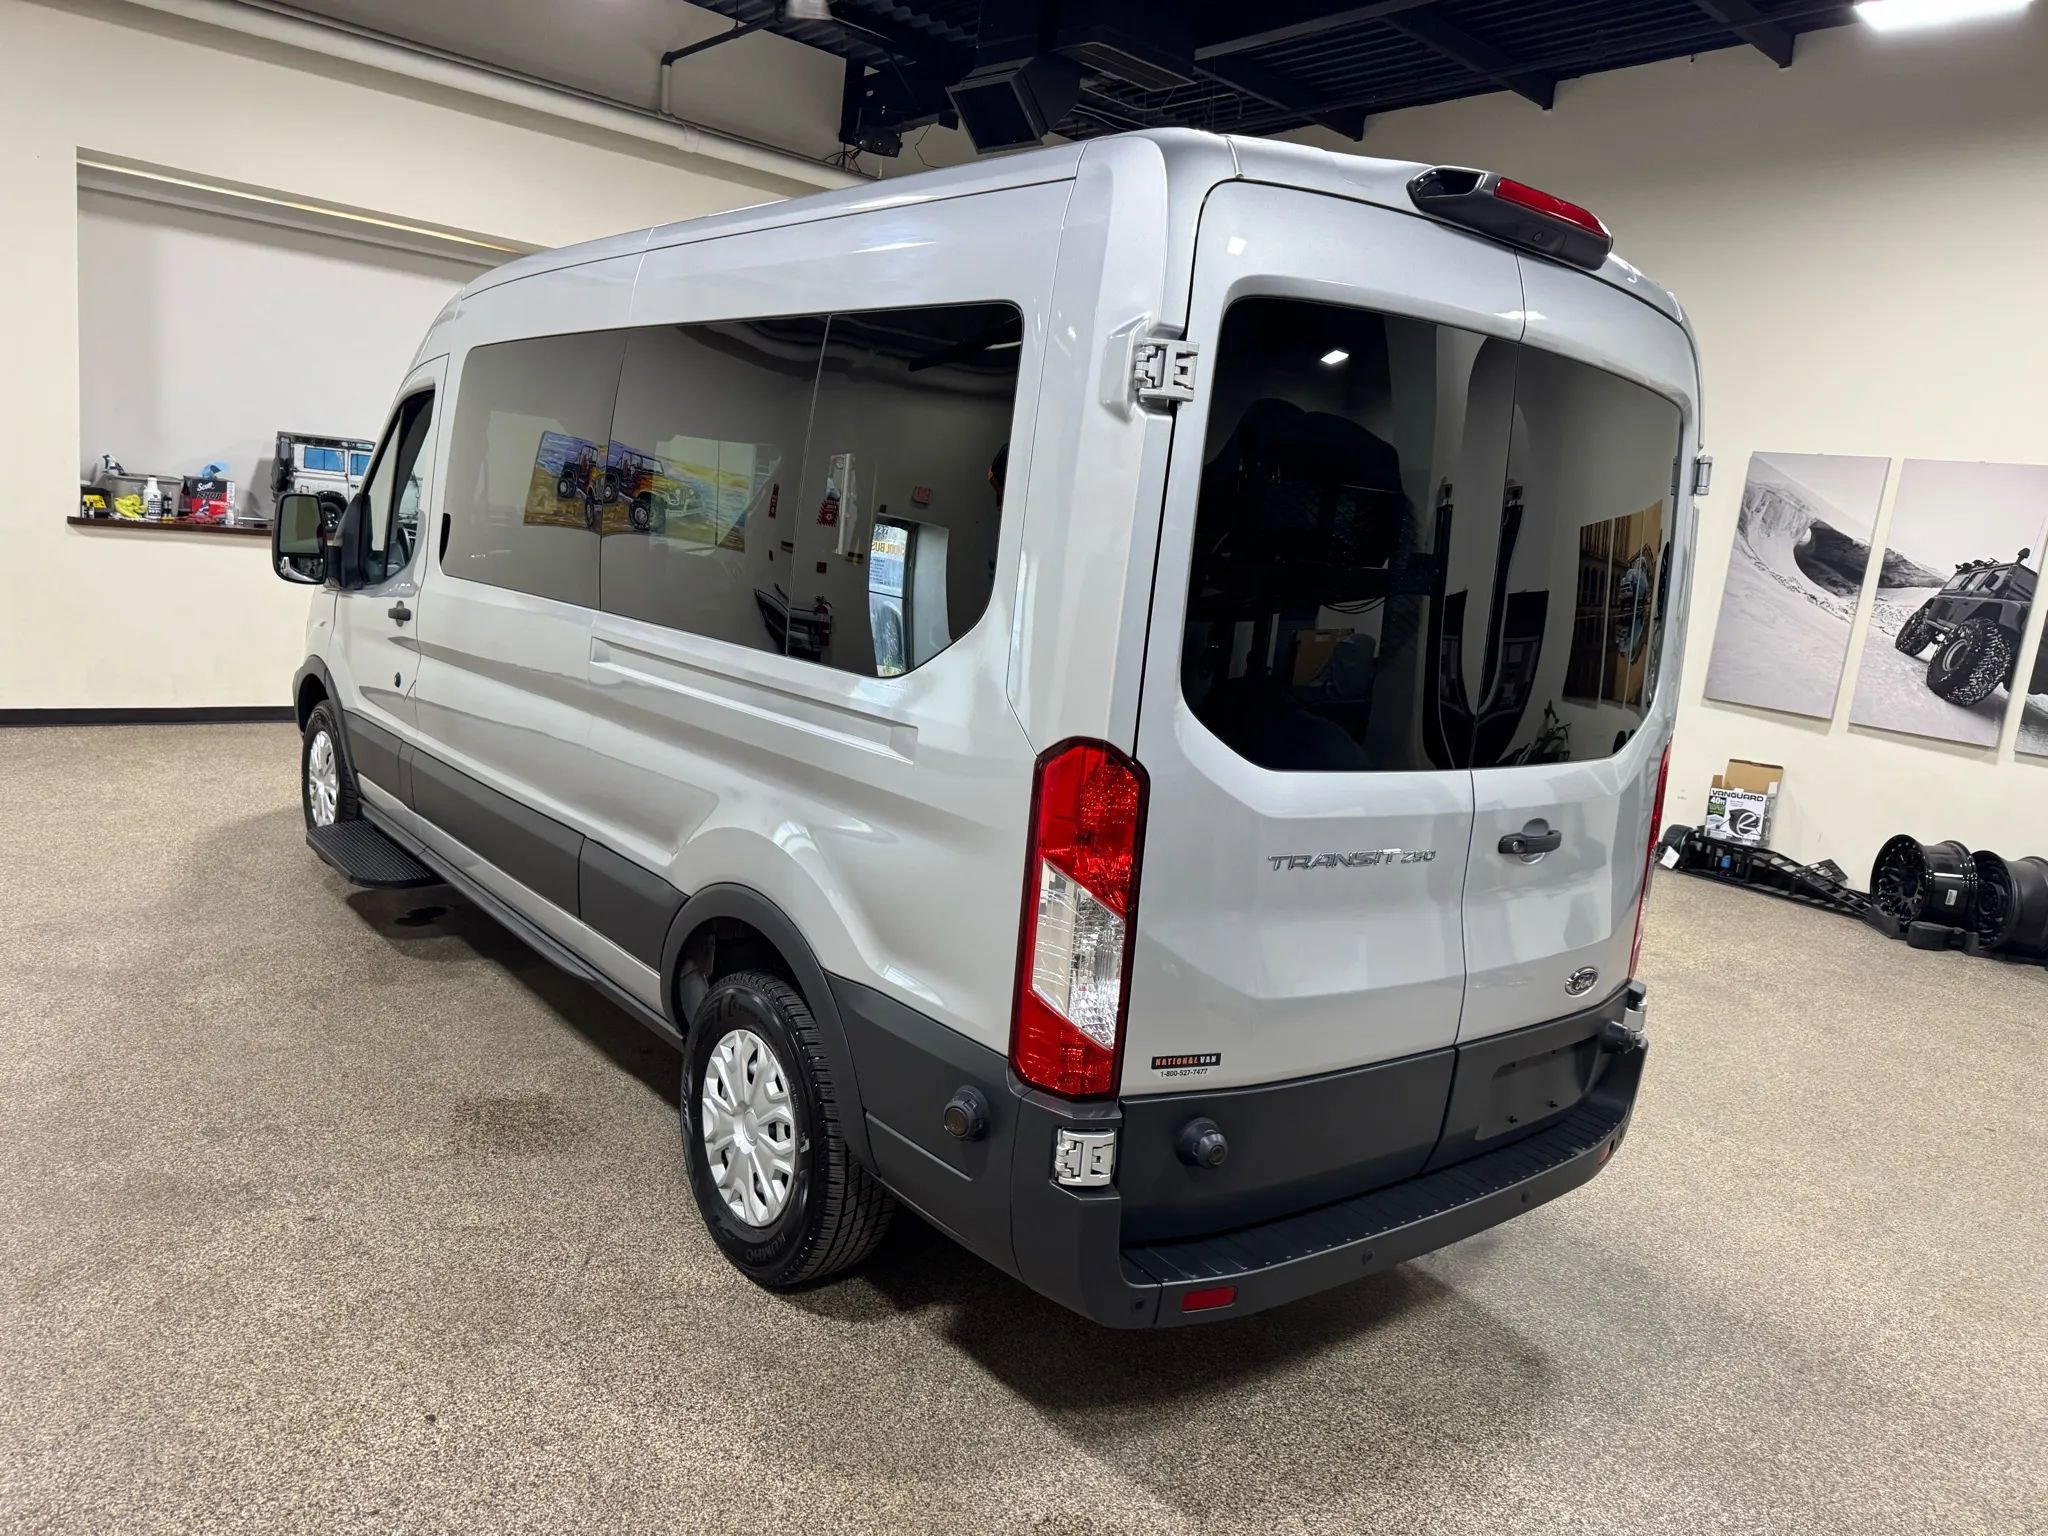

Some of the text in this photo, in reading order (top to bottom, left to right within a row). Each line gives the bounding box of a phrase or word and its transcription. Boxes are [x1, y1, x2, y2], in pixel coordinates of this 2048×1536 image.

[1712, 789, 1764, 802] VANGUARD
[1268, 848, 1436, 871] TRANSIT 250
[1155, 1055, 1217, 1066] NATIONAL VAN
[1160, 1068, 1208, 1077] 1-800-527-7477
